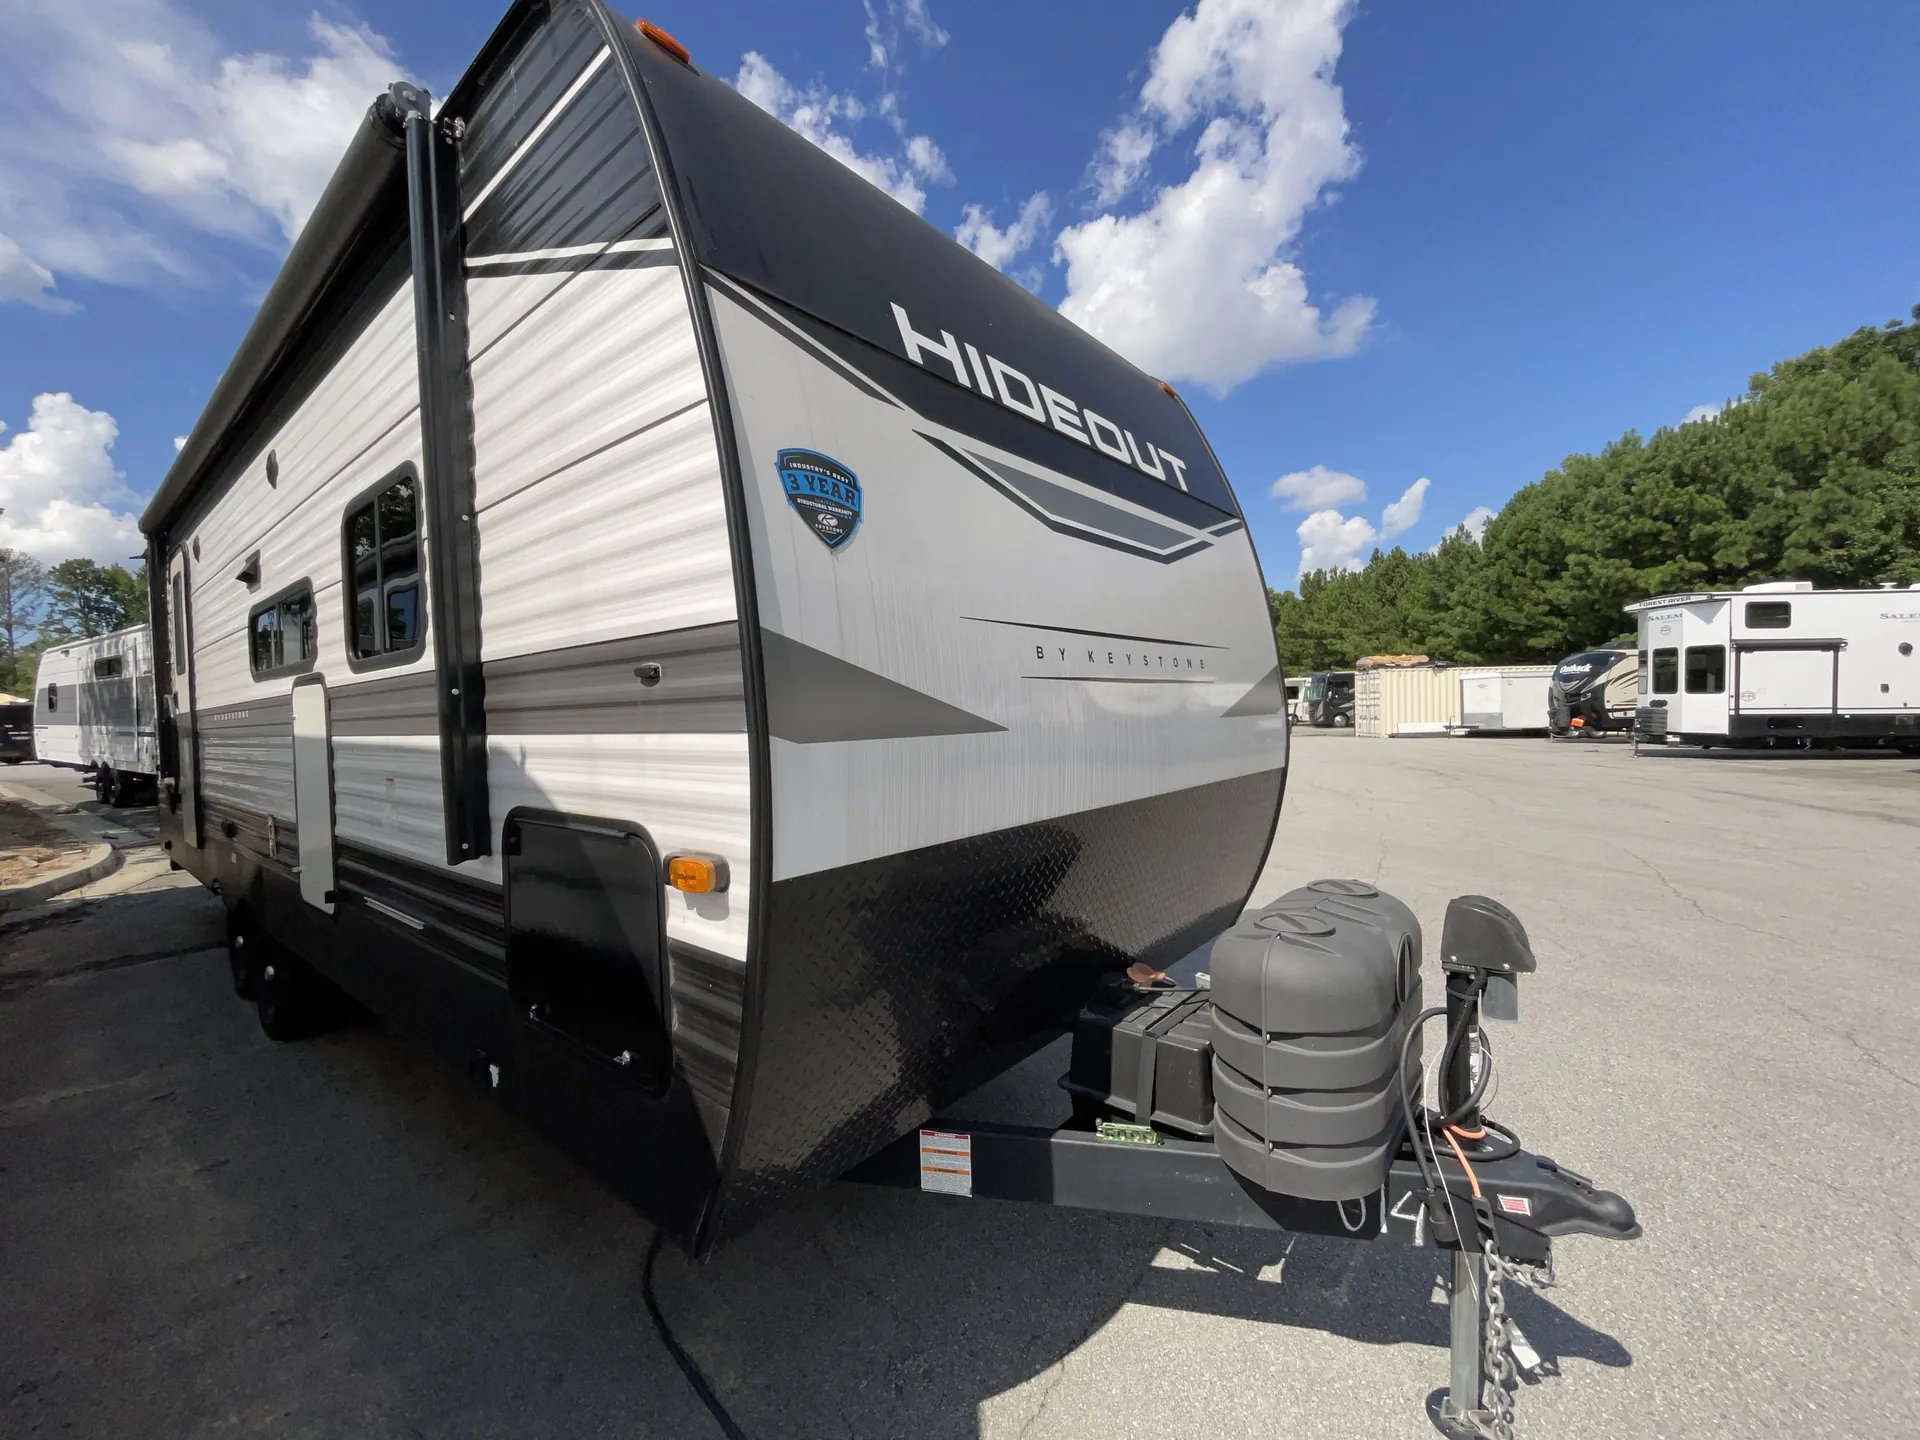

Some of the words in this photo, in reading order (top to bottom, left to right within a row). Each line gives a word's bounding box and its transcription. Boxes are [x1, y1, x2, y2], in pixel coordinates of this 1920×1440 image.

[890, 301, 1188, 492] HIDEOUT
[789, 462, 831, 476] INDUSTRY'S
[787, 473, 800, 491] 3
[803, 474, 856, 506] YEAR
[797, 498, 827, 509] STRUCTURAL
[828, 505, 852, 515] WARRANTY
[815, 523, 843, 534] KEYSTONE
[1648, 613, 1683, 622] SALEM
[1036, 646, 1065, 660] BY
[1088, 650, 1204, 670] KEYSTONE
